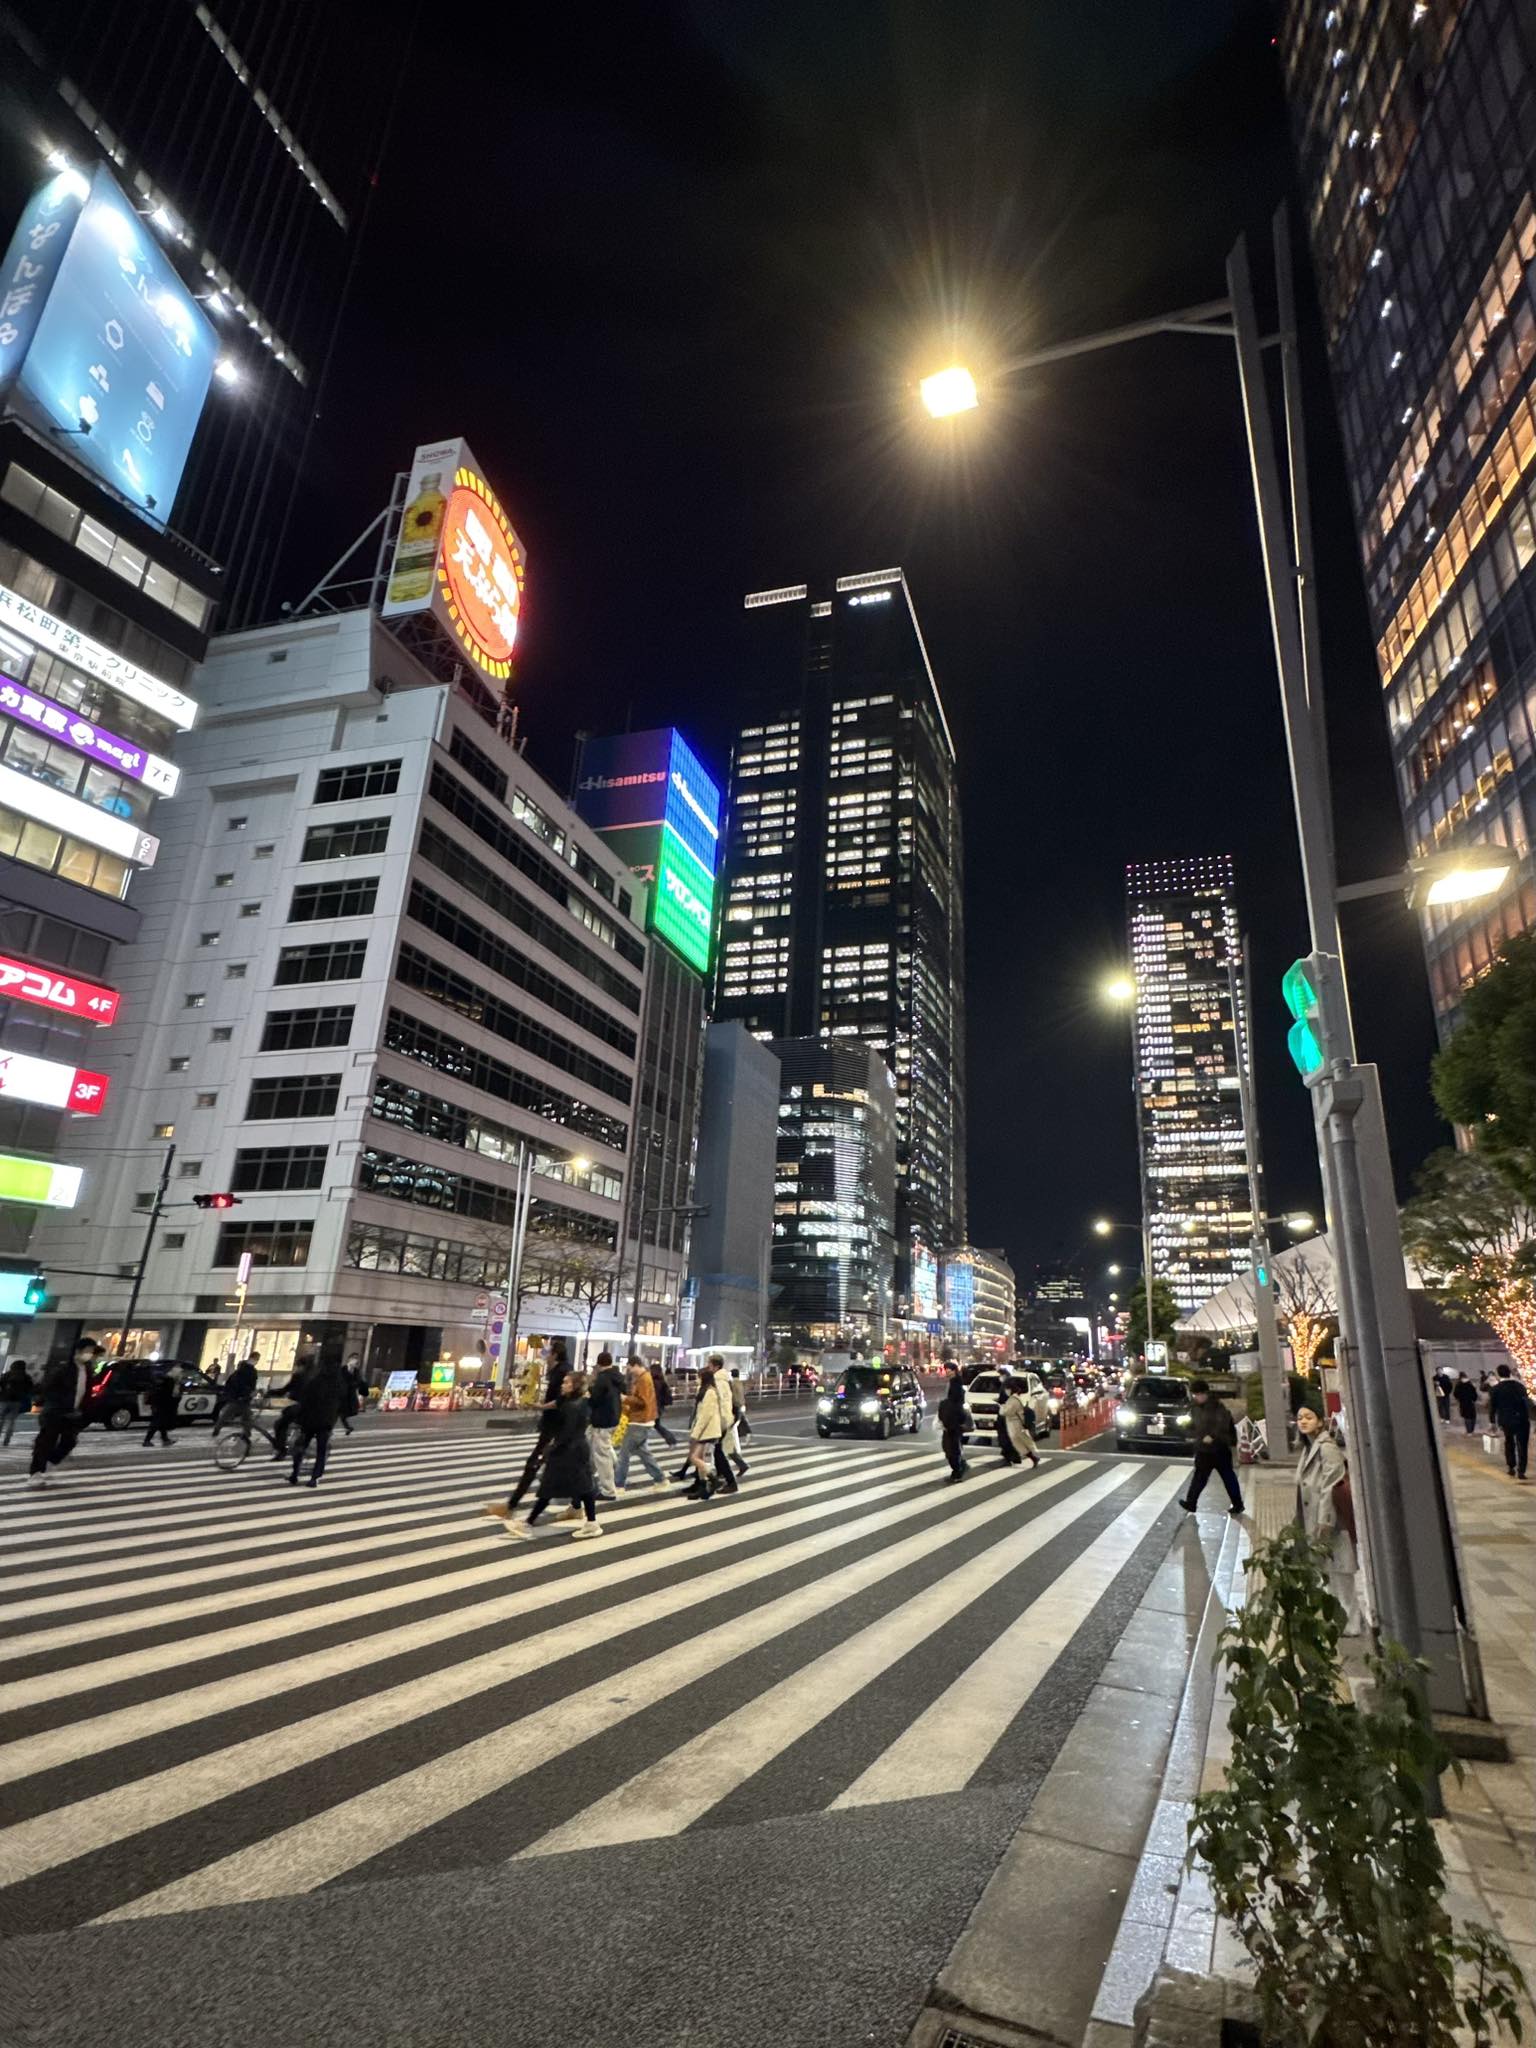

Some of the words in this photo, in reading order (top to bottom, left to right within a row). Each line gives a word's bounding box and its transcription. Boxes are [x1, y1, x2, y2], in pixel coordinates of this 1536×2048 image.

[579, 771, 666, 791] Hisamitsu
[0, 963, 75, 1007] アコム
[88, 996, 113, 1013] 4F
[74, 1083, 101, 1100] 3F
